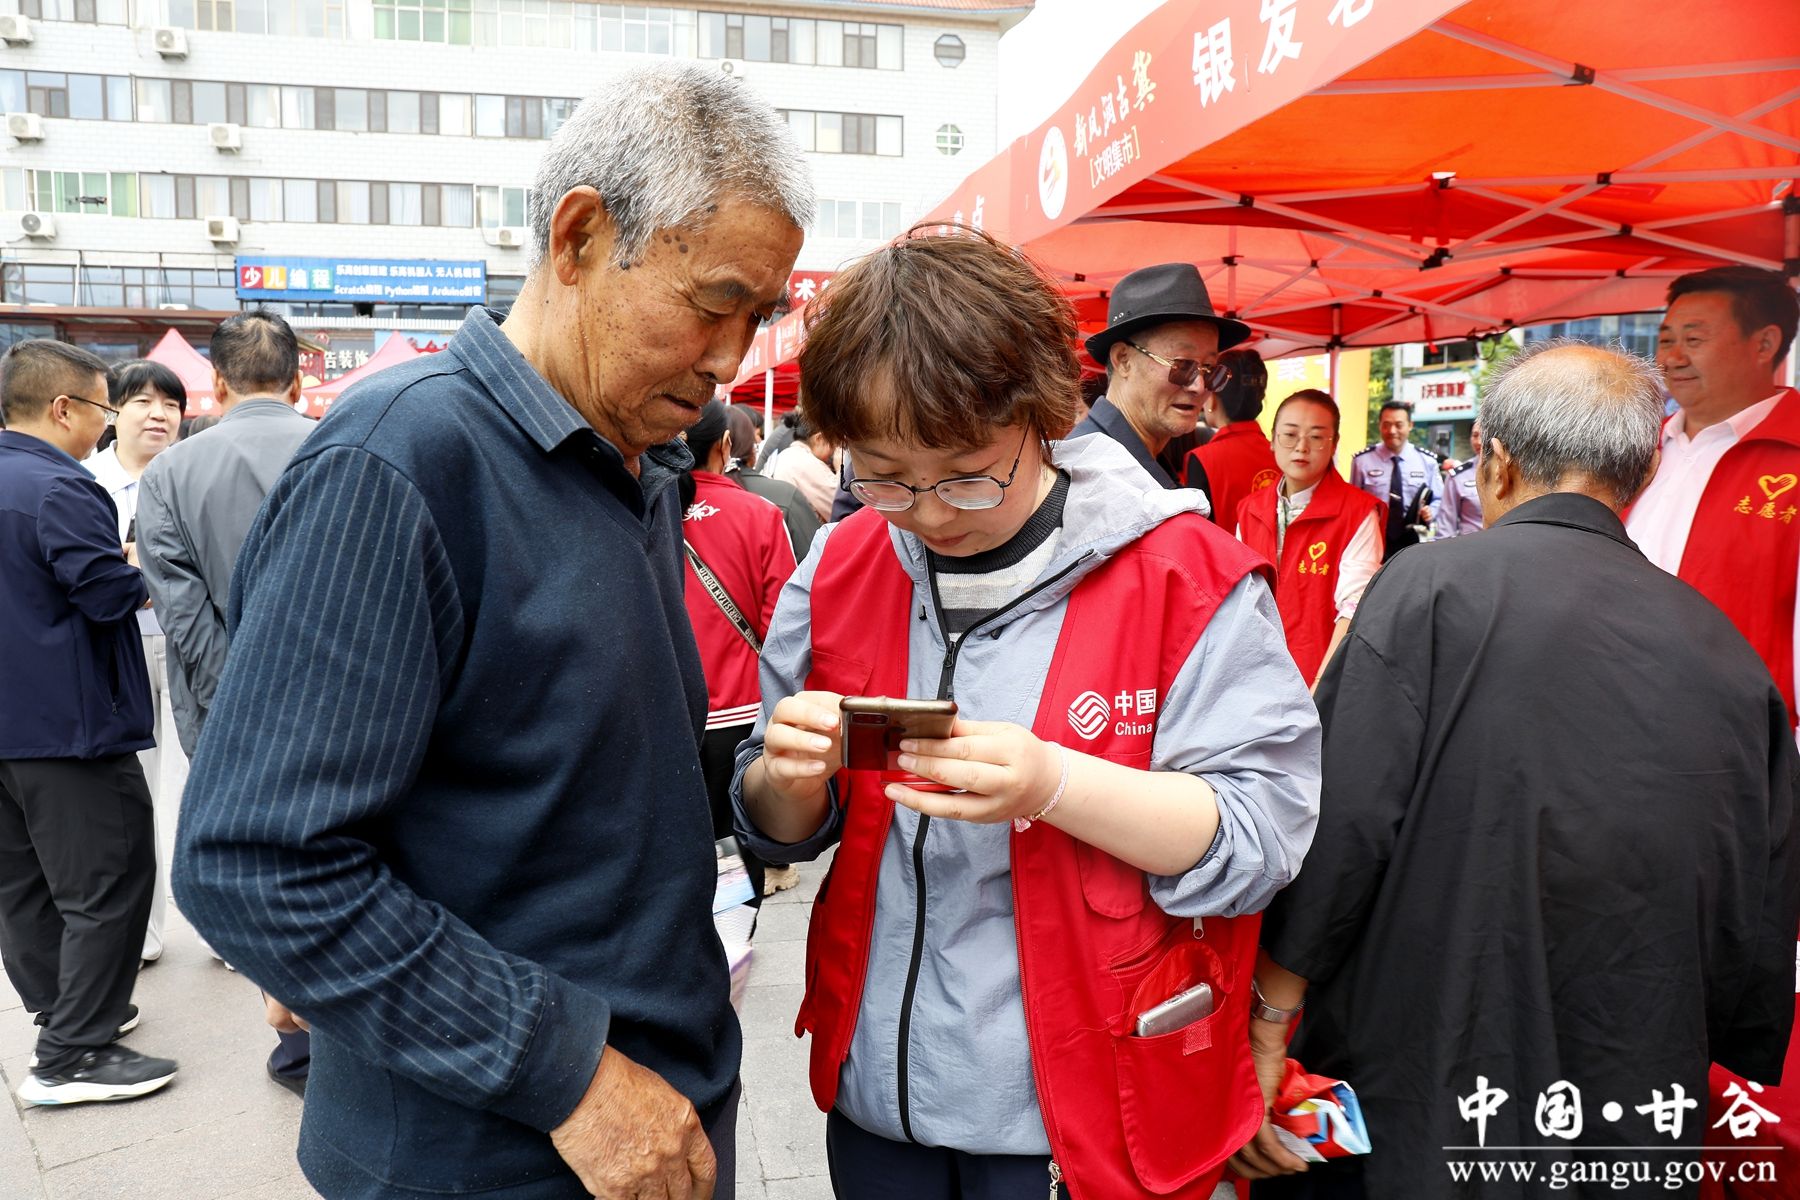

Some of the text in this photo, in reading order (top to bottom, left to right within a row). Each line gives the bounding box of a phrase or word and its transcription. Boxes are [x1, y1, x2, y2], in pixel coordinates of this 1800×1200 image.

[244, 266, 331, 290] 少儿编程
[389, 265, 433, 277] 乐高机器人
[435, 267, 481, 278] 无人机编程
[1733, 495, 1798, 525] 志愿者
[1114, 688, 1157, 717] 中国
[1115, 721, 1153, 736] China
